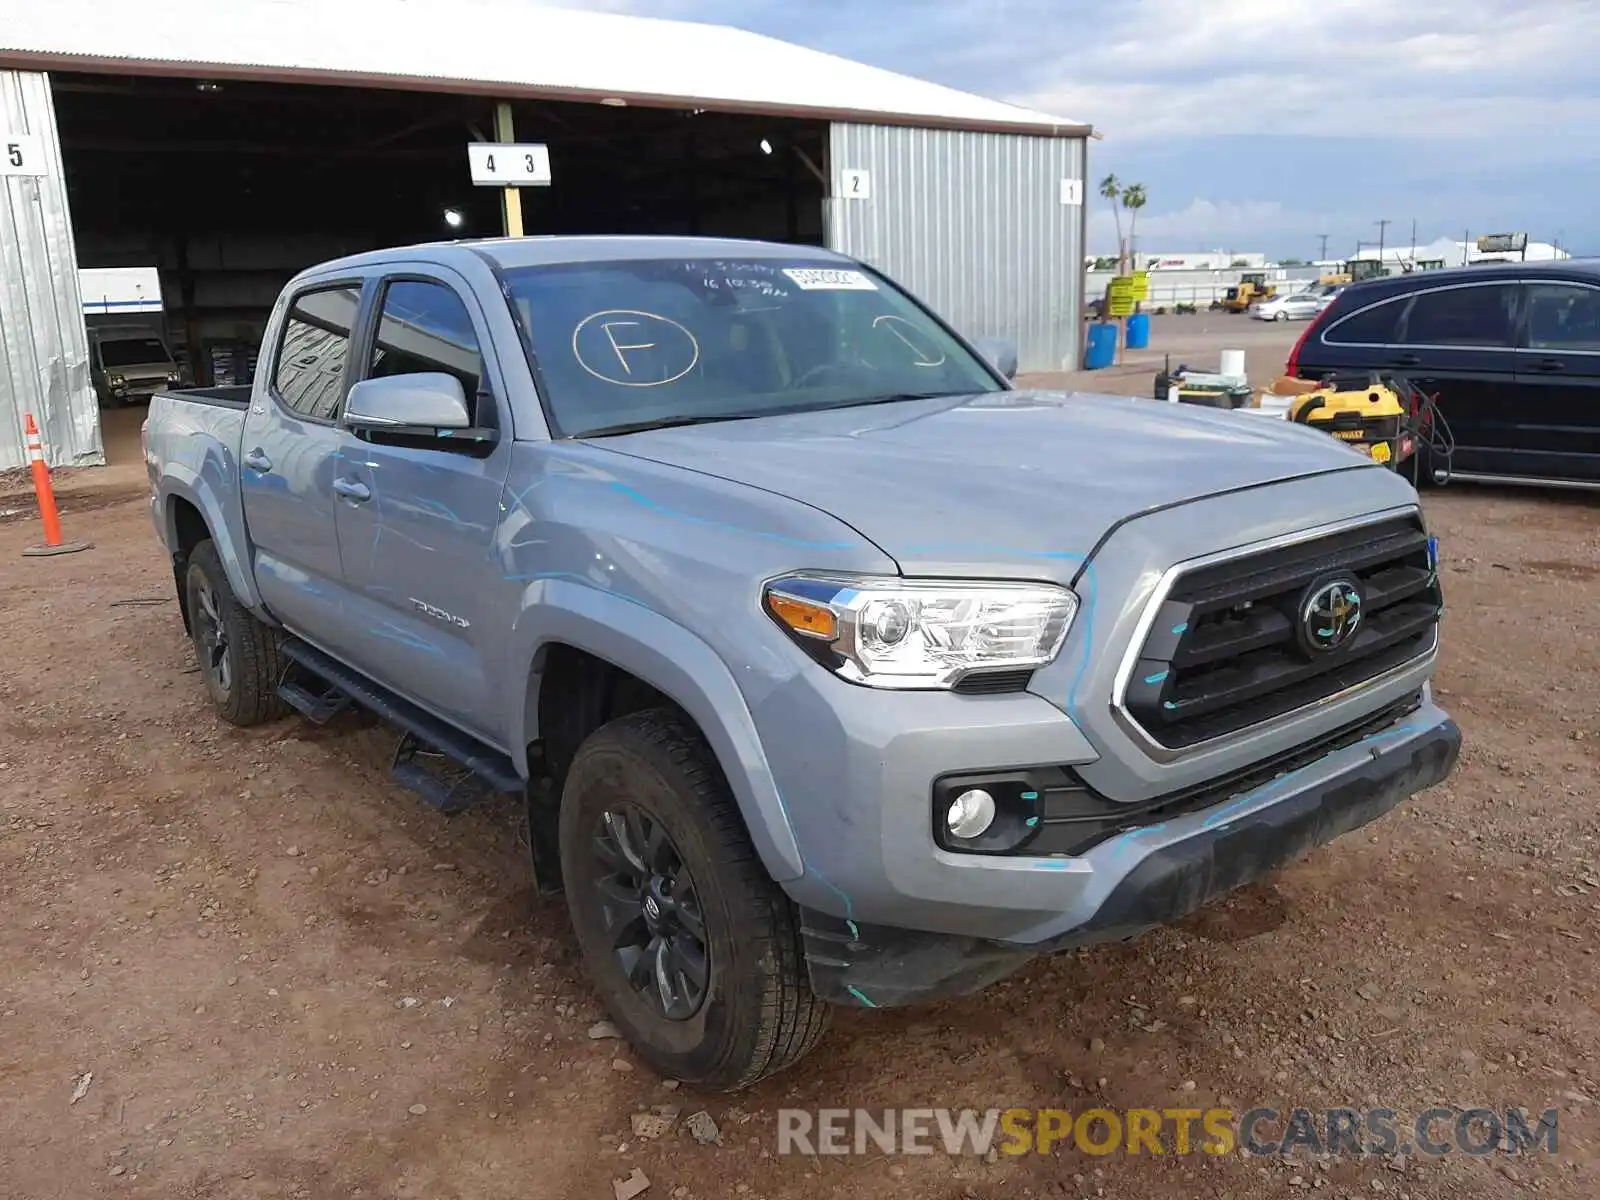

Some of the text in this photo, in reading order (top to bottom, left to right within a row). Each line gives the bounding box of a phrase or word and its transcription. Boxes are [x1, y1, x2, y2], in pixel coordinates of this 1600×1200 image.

[7, 143, 24, 167] 5
[487, 154, 535, 173] 4 3
[852, 175, 861, 193] 2
[601, 321, 655, 375] F
